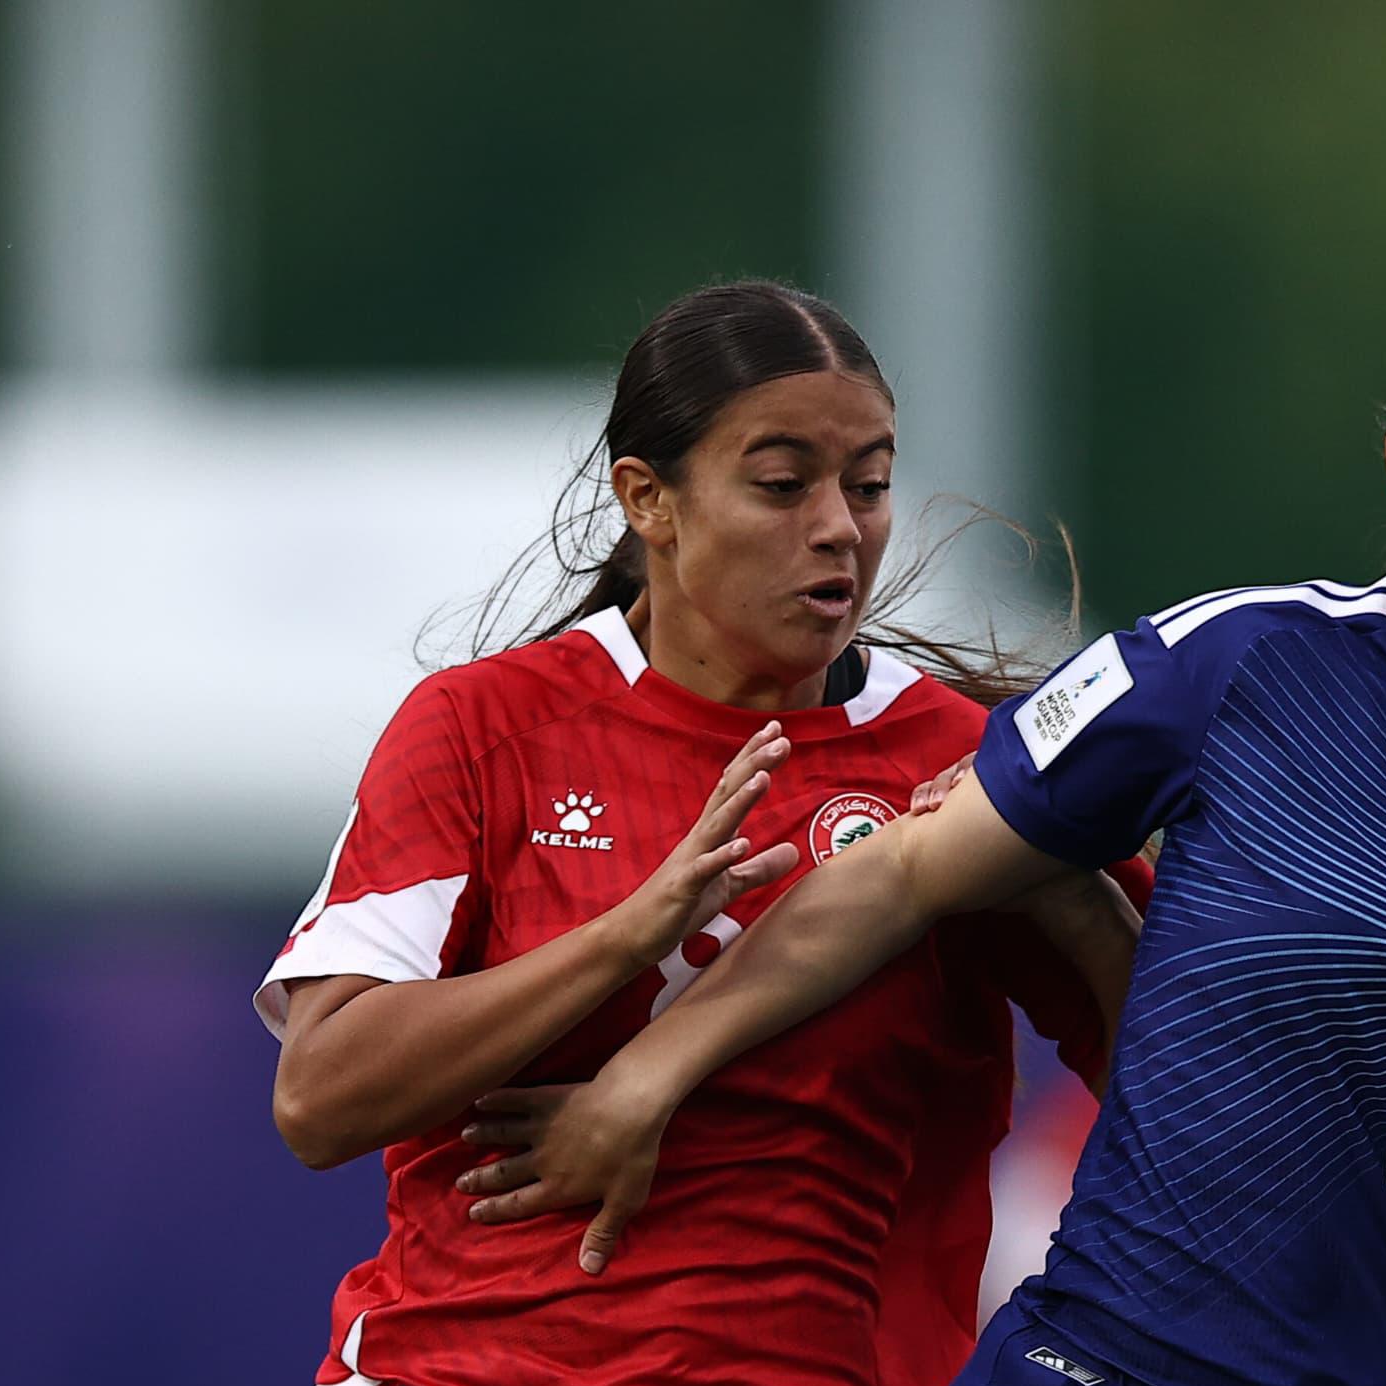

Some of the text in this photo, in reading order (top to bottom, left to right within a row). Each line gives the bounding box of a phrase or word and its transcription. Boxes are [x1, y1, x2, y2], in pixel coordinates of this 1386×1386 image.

[1036, 699, 1053, 726] ASIAN
[1048, 724, 1061, 741] CUP
[531, 829, 613, 850] KELME
